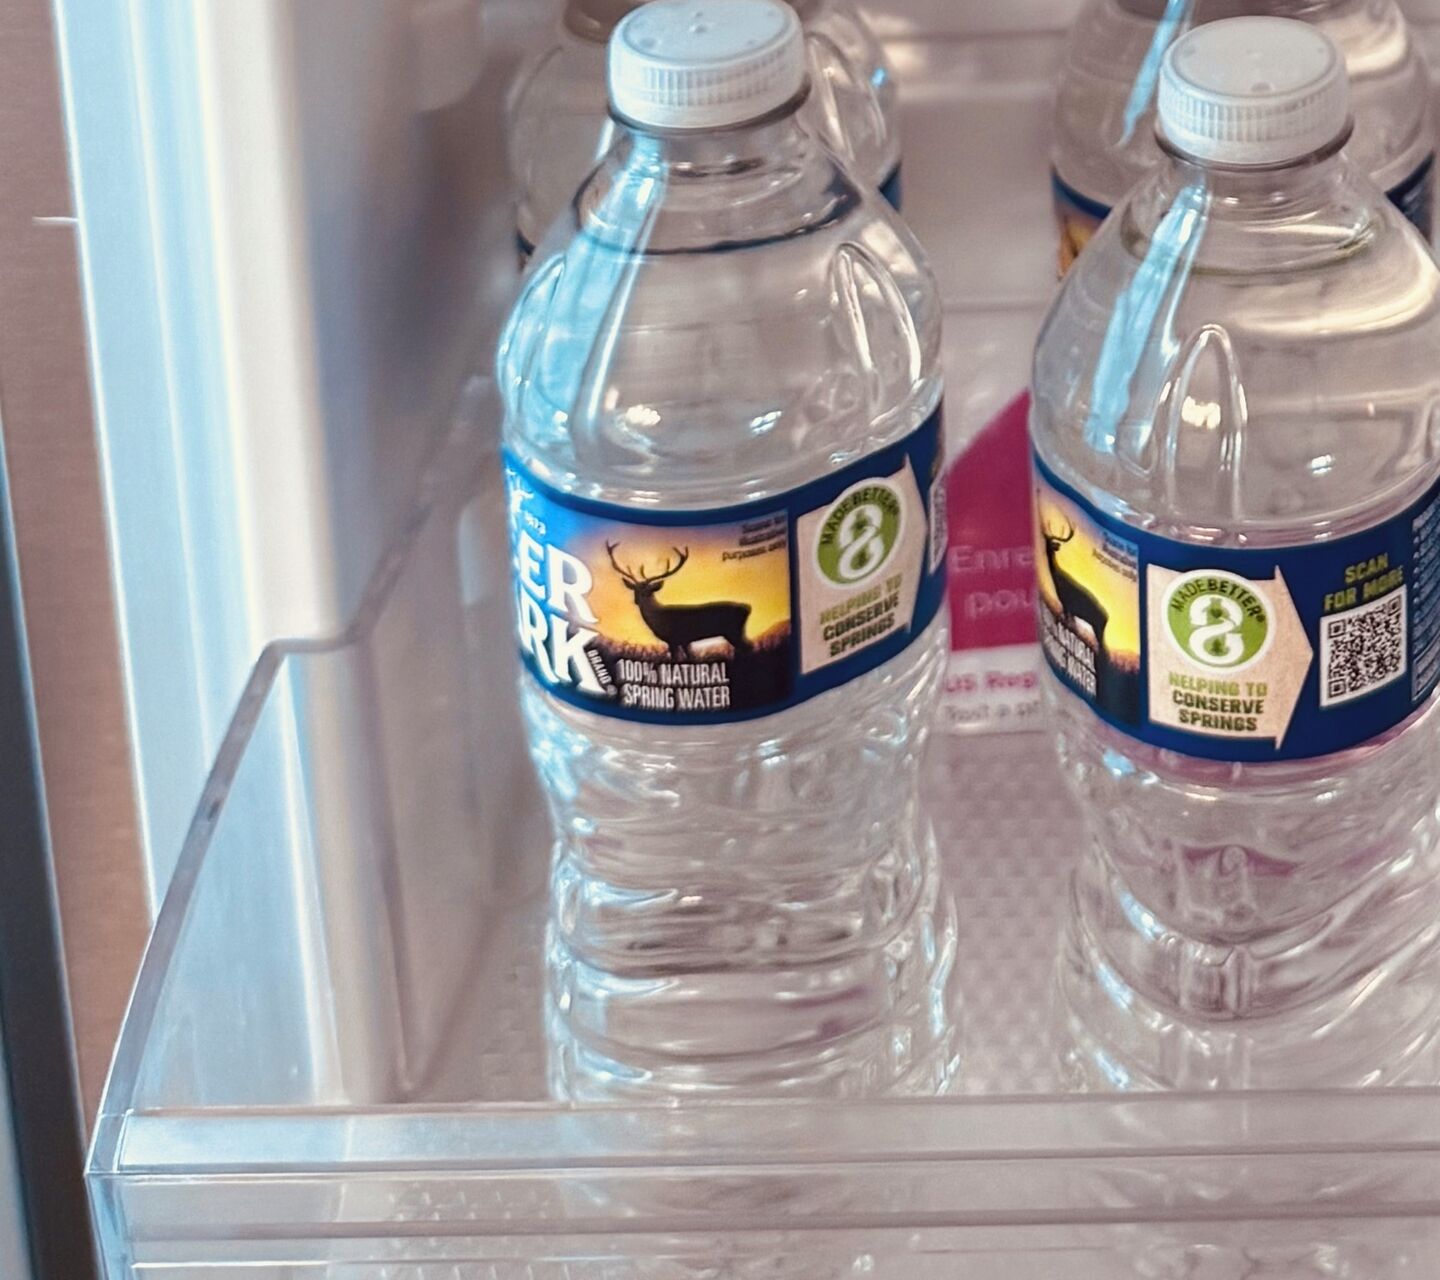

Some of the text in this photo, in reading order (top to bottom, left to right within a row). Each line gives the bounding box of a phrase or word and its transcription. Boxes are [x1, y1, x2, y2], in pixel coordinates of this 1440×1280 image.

[514, 528, 600, 624] ER
[1344, 552, 1388, 584] SCAN
[1169, 577, 1263, 618] MADE BETTER
[1324, 587, 1357, 612] FOR
[823, 592, 900, 642] CONSERVE
[517, 584, 608, 695] RK
[829, 612, 896, 658] SPRINGS
[616, 658, 731, 686] 100% NATURAL
[1168, 669, 1269, 698] HELPING TO
[623, 683, 731, 709] SPRING WATER
[1172, 689, 1265, 715] CONSERVE
[1178, 707, 1258, 732] SPRINGS
